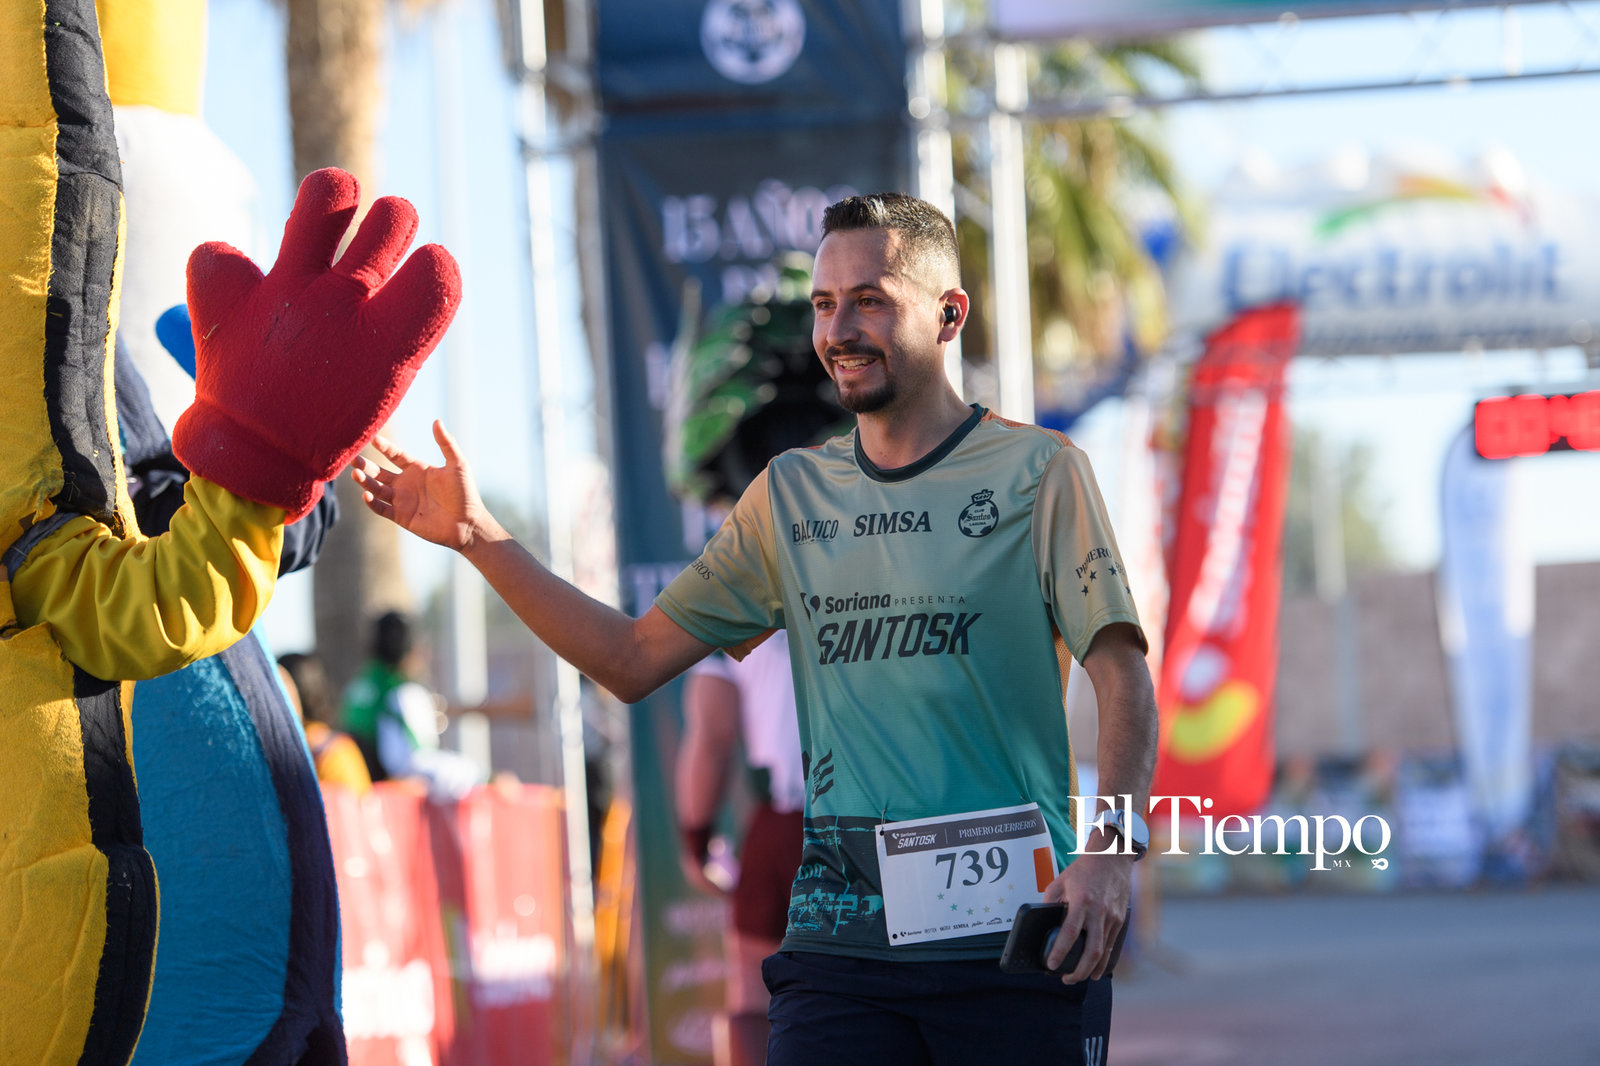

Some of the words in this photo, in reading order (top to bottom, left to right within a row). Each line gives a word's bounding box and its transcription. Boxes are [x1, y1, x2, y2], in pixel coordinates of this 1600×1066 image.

[719, 178, 862, 260] AÑO
[792, 519, 839, 543] BALTICO
[853, 510, 932, 537] SIMSA
[825, 591, 891, 614] Soriana
[894, 595, 967, 607] PRESENTA
[817, 612, 983, 665] SANTOSK
[897, 833, 937, 849] SANTOSK
[958, 825, 994, 839] PRIMERO
[994, 818, 1037, 834] GUERREROS
[935, 846, 1009, 890] 739
